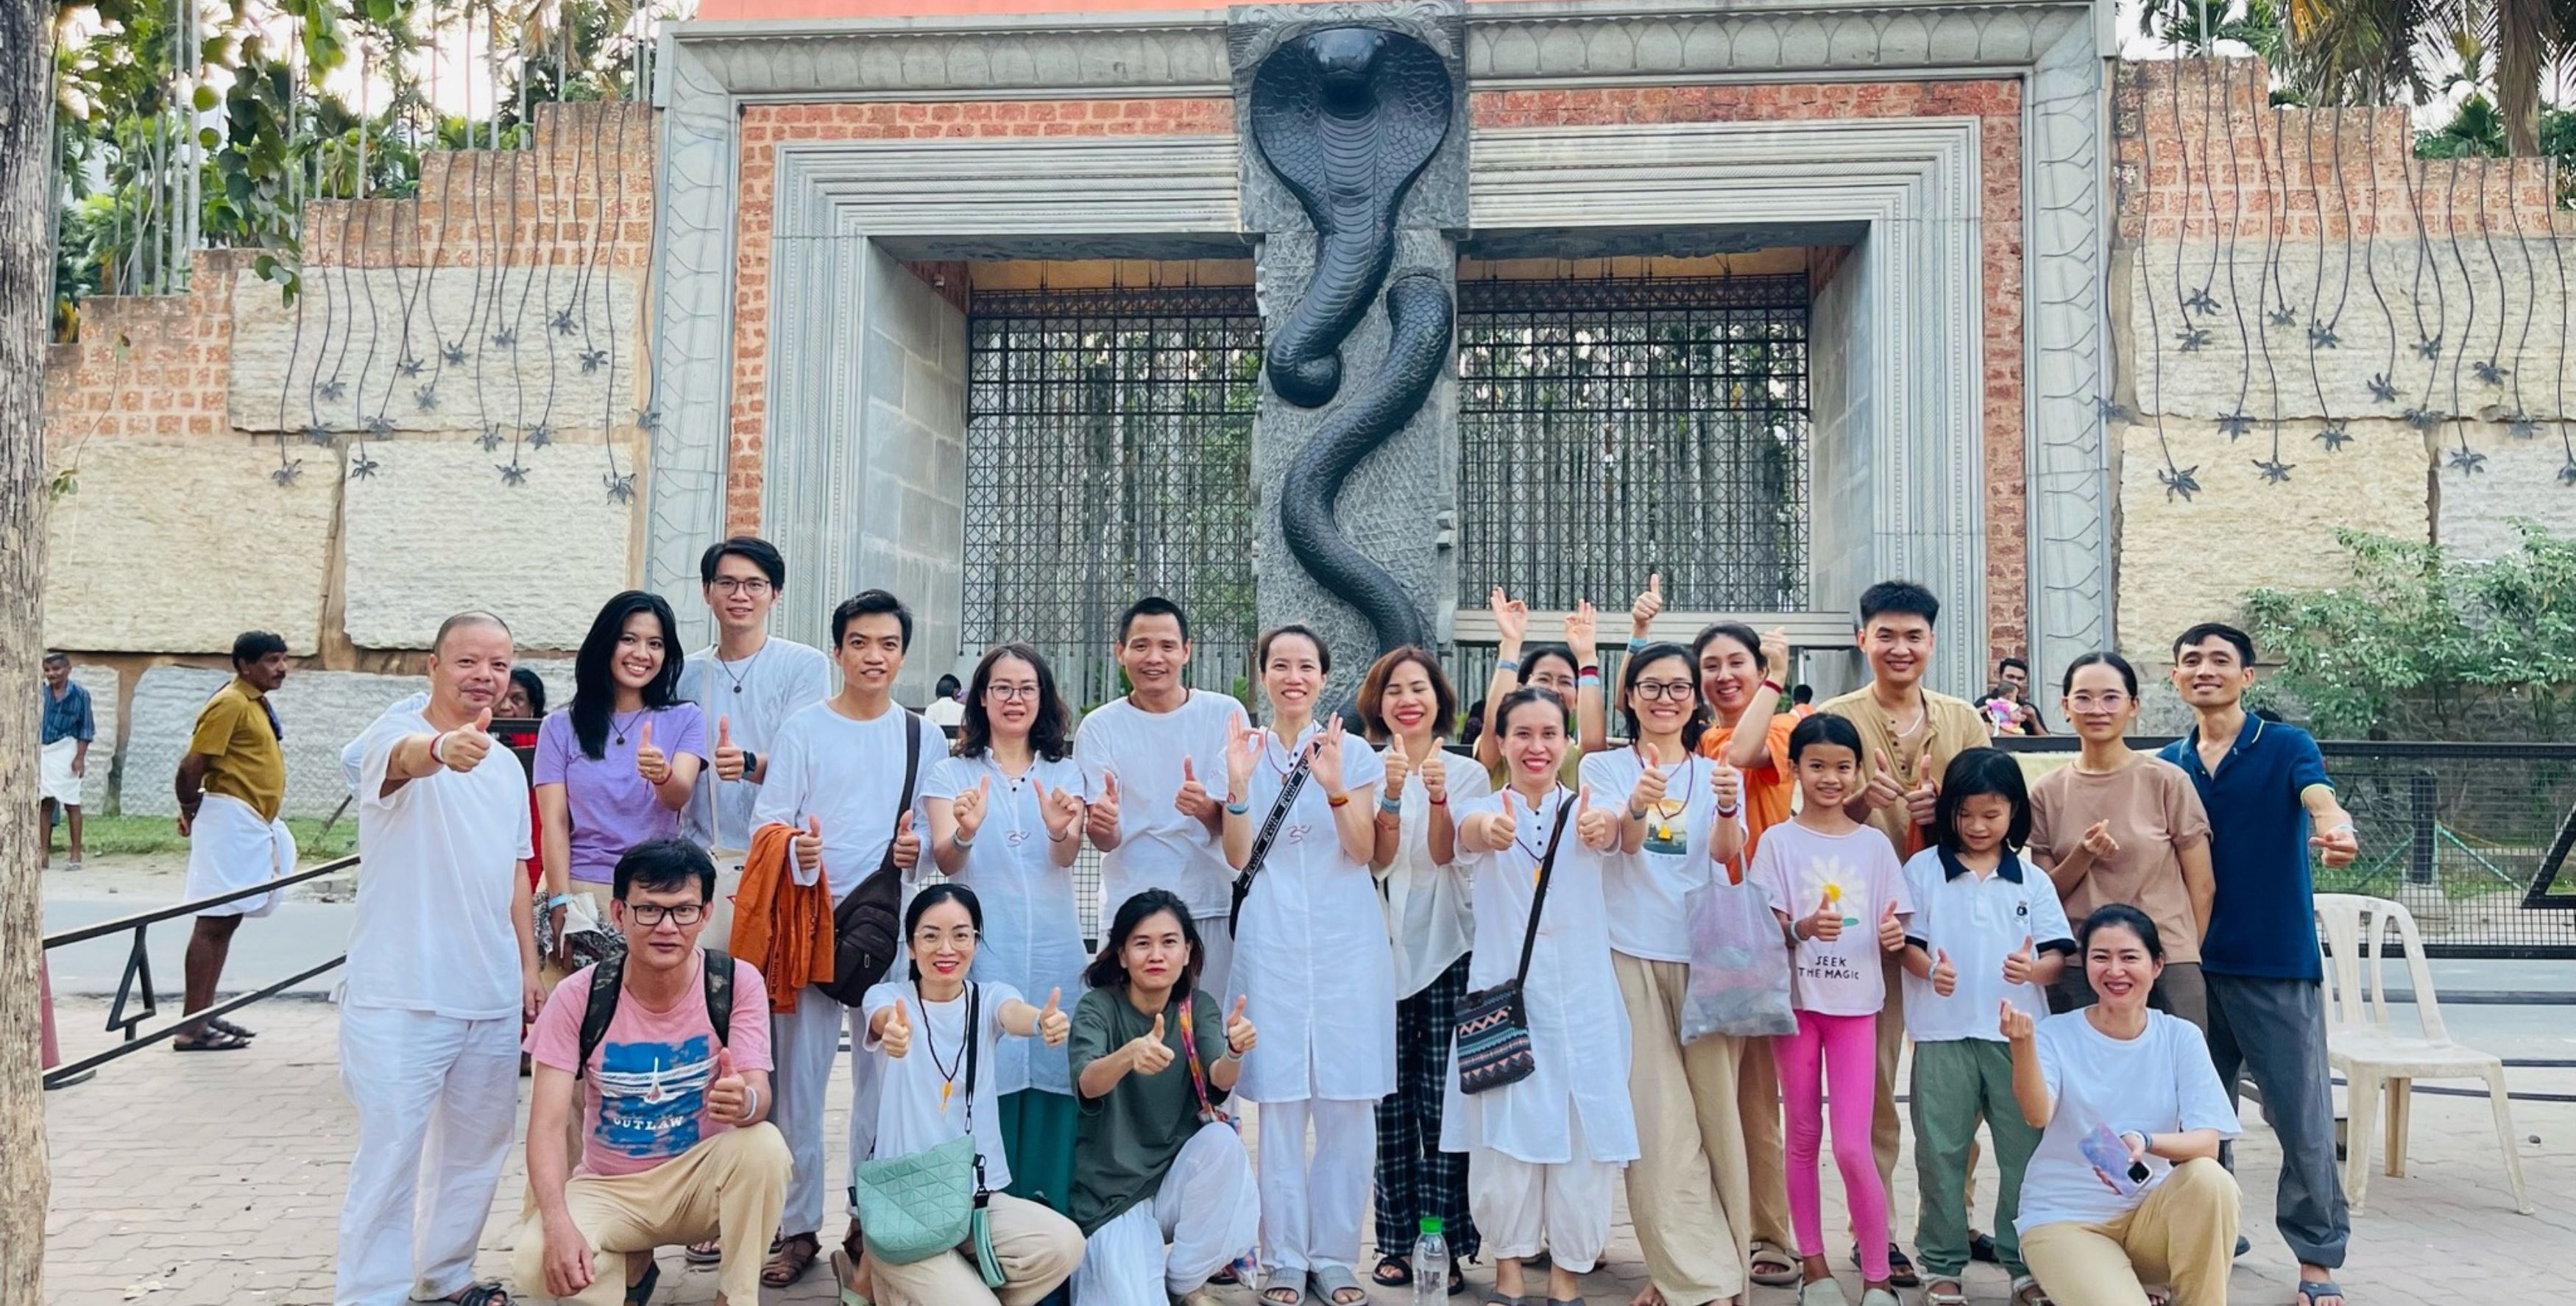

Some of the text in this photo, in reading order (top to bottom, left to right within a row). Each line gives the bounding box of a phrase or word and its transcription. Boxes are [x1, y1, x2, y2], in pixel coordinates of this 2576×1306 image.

[1816, 956, 1847, 967] SEEK
[1798, 967, 1859, 980] THE MAGIC
[613, 1115, 684, 1130] OUTLAW
